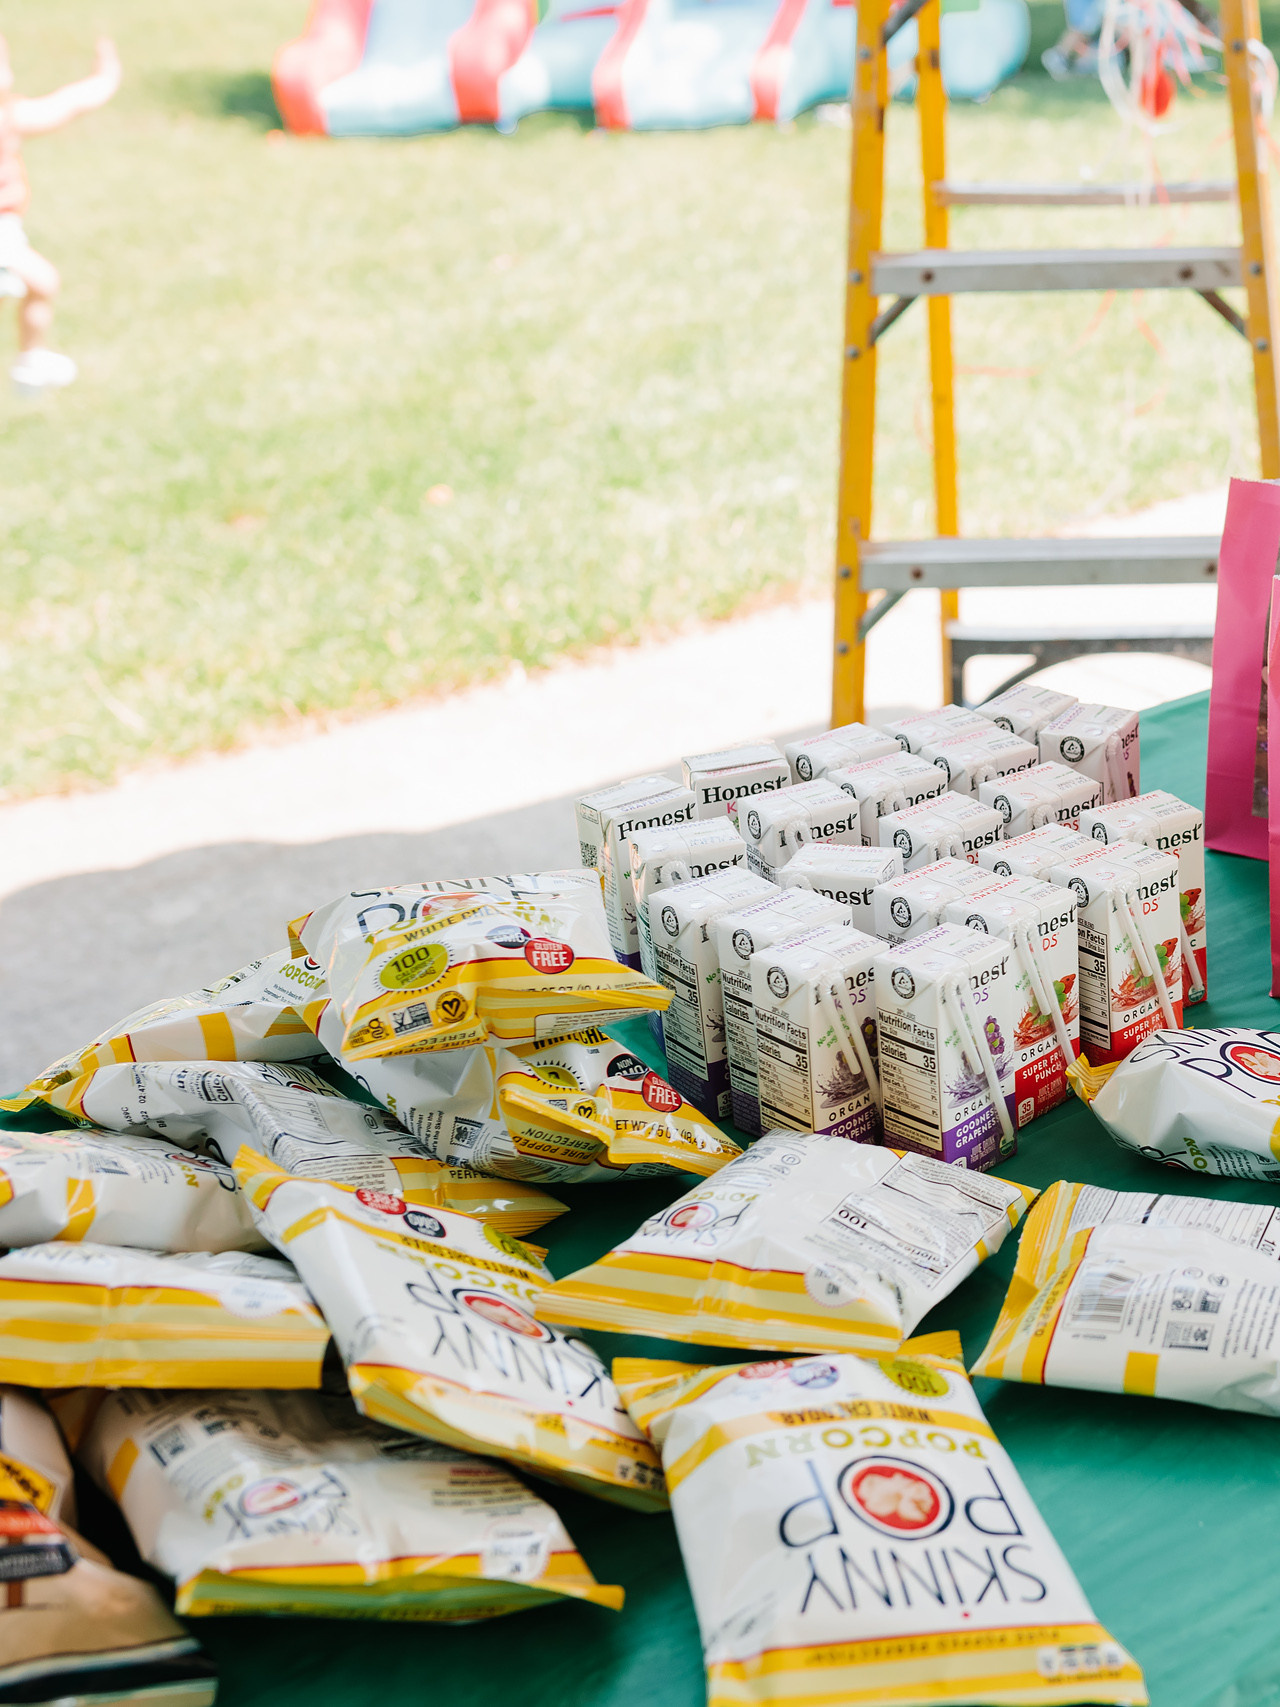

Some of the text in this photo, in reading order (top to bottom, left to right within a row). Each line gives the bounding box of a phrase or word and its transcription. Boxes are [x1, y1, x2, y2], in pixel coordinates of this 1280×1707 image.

[702, 776, 788, 805] Honest
[1041, 791, 1103, 824] nest
[617, 802, 696, 842] Honest
[787, 813, 858, 844] nest
[1150, 823, 1203, 850] nest
[658, 854, 744, 884] nest
[808, 887, 874, 906] nest
[1122, 870, 1178, 906] nest
[403, 916, 457, 942] WHITE
[1022, 904, 1077, 942] nest
[533, 942, 563, 951] GLUTEN
[1086, 931, 1105, 946] Facts
[391, 946, 430, 973] 100
[532, 950, 570, 967] FREE
[1094, 959, 1106, 973] 35
[722, 972, 752, 993] Nutrition
[951, 956, 1010, 996] nest
[687, 989, 698, 1004] 35
[724, 1001, 750, 1021] Calories
[755, 1008, 807, 1040] Nutrition Facts
[406, 1030, 477, 1048] PERFECT
[878, 1010, 912, 1032] Nutrition
[913, 1024, 935, 1041] Facts
[1123, 1012, 1164, 1040] SUPER FRU
[756, 1038, 808, 1069] Calories 35
[880, 1041, 936, 1070] Calories 35
[1021, 1034, 1062, 1062] ORGAN
[616, 1058, 634, 1069] NON
[1023, 1052, 1063, 1080] SUPER FRU
[1035, 1063, 1063, 1083] PUNCH
[648, 1085, 680, 1107] FREE
[828, 1094, 872, 1122] ORGAN
[954, 1091, 997, 1121] ORGAN
[1021, 1101, 1032, 1114] 35
[614, 1119, 628, 1131] ET
[955, 1117, 997, 1149] GRAPENES
[956, 1107, 996, 1137] GOODNES
[513, 1135, 593, 1161] PURE POPPED
[449, 1169, 496, 1180] PERFE
[837, 1208, 868, 1231] 100
[433, 1314, 622, 1411] KINNY
[879, 1401, 935, 1423] WHITE
[744, 1424, 989, 1470] POPCORN
[779, 1454, 1025, 1549] POP
